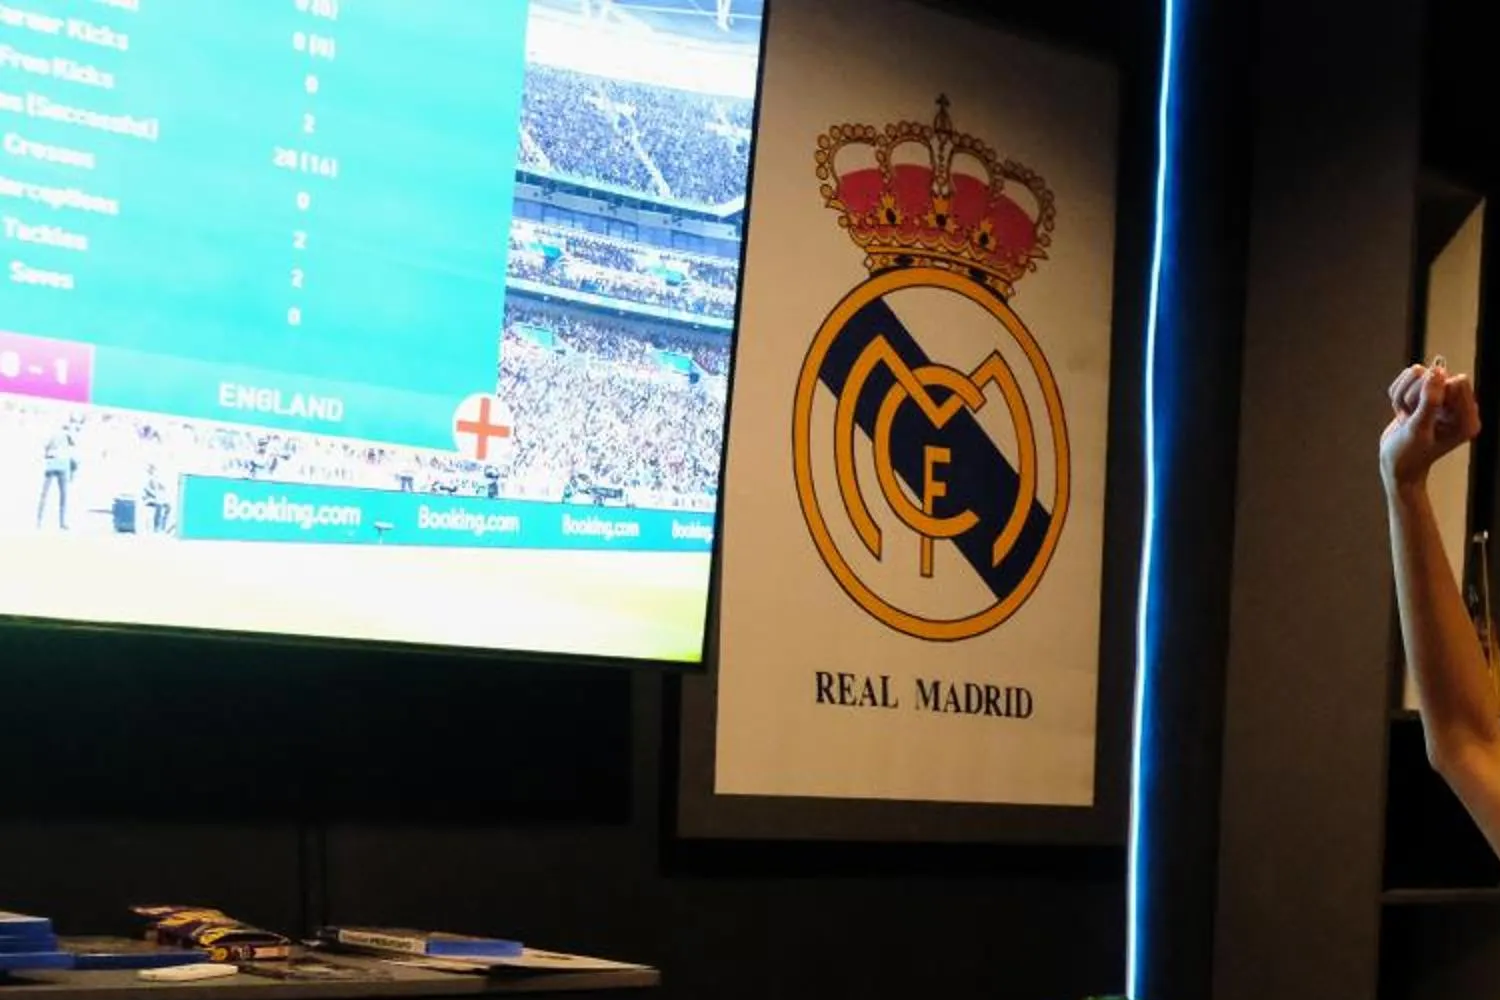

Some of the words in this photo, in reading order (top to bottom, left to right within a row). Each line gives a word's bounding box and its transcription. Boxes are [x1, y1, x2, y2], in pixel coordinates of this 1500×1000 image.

[290, 267, 304, 289] 2
[218, 381, 345, 422] ENGLAND
[222, 493, 362, 529] Booking.com
[418, 505, 521, 535] Booking.com
[815, 671, 899, 709] REAL
[914, 678, 1034, 719] MADRID
